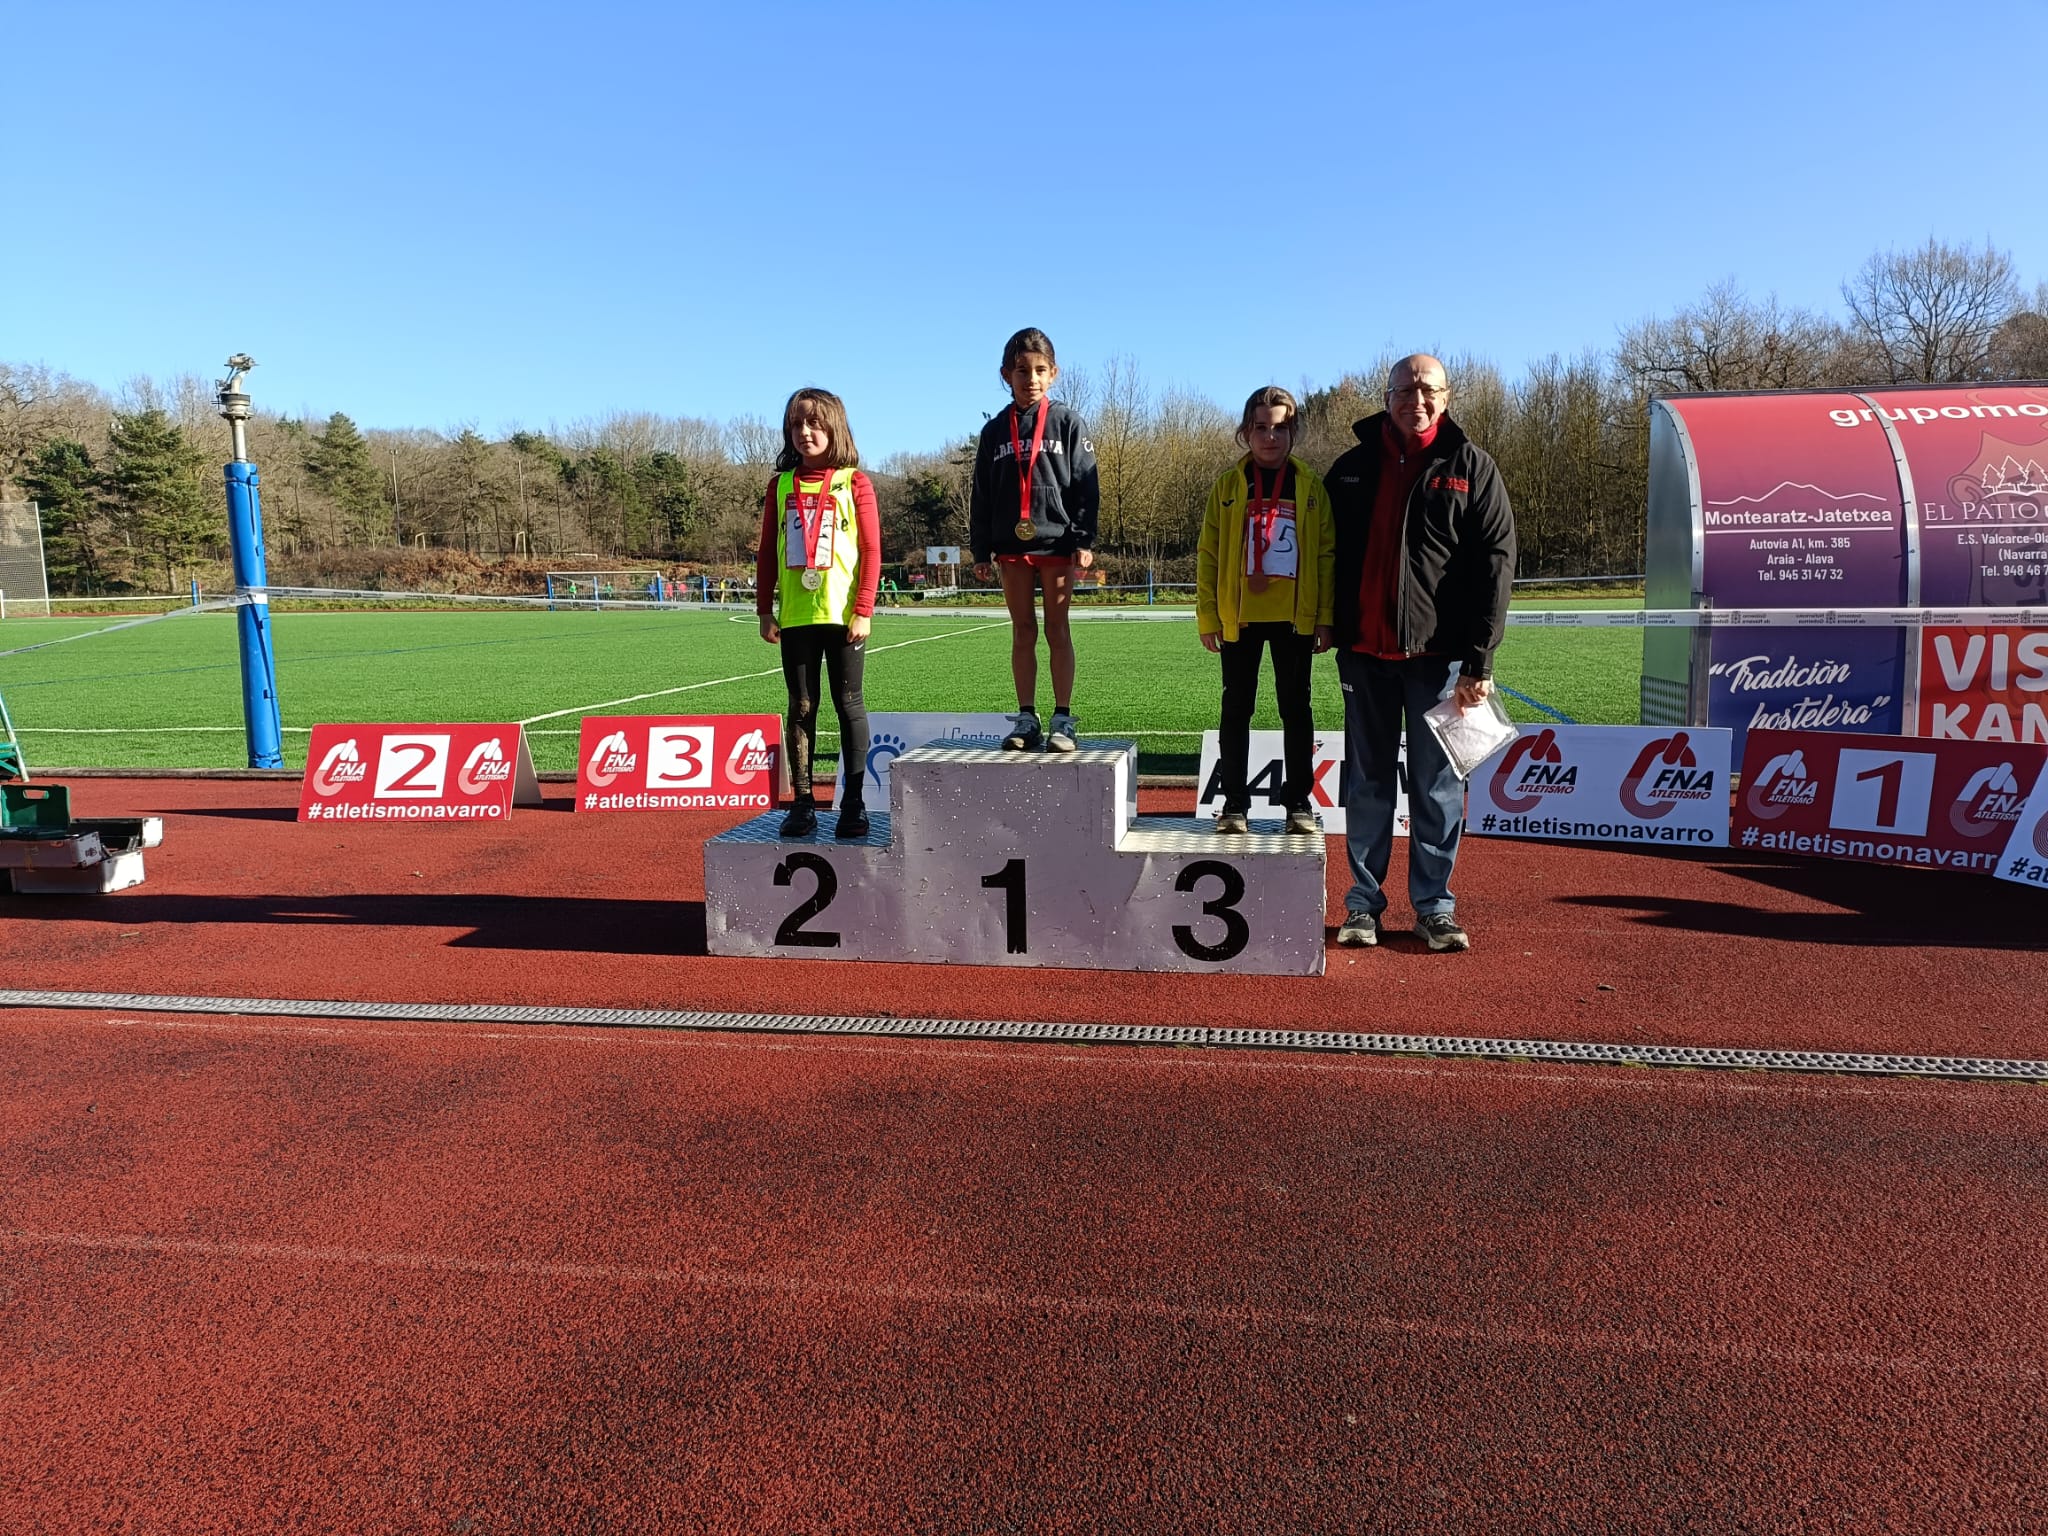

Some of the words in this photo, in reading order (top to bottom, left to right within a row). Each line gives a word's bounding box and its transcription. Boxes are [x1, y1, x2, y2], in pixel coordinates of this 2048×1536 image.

[1705, 508, 1892, 525] Montearatz-Jatetxea
[1923, 502, 1954, 520] EL
[1962, 501, 2039, 520] PATIO
[1750, 538, 1789, 550] Autovía
[1792, 538, 1805, 550] A1,
[1808, 538, 1828, 549] km.
[1831, 537, 1850, 549] 385
[1957, 534, 1979, 545] E.S.
[1767, 554, 1795, 565] Araia
[1805, 553, 1834, 565] Alava
[1758, 570, 1776, 581] Tel.
[1779, 569, 1799, 581] 945
[1801, 569, 1811, 580] 31
[1814, 569, 1828, 580] 47
[1830, 569, 1843, 580] 32
[1981, 565, 2000, 577] Tel.
[2003, 565, 2024, 576] 948
[2027, 565, 2041, 576] 46
[1934, 633, 2048, 692] VIS
[604, 753, 637, 767] FNA
[658, 734, 703, 781] 3
[743, 751, 774, 765] FNA
[333, 762, 368, 776] FNA
[384, 743, 437, 791] 2
[476, 761, 511, 775] FNA
[1520, 764, 1578, 785] FNA
[1653, 769, 1714, 791] FNA
[1772, 779, 1819, 798] FNA
[1515, 784, 1574, 795] ATLETISMO
[1648, 788, 1711, 800] ATLETISMO
[1856, 759, 1904, 828] 1
[584, 792, 769, 809] #atletismonavarro
[1768, 795, 1815, 805] ATLETISMO
[308, 802, 500, 819] #atletismonavarro
[1973, 811, 2020, 821] ATLETISM
[1482, 813, 1714, 843] #atletismonavarro
[1741, 826, 1998, 870] #atletismonavarr
[773, 851, 841, 948] 2
[981, 859, 1028, 954] 1
[1171, 860, 1250, 962] 3
